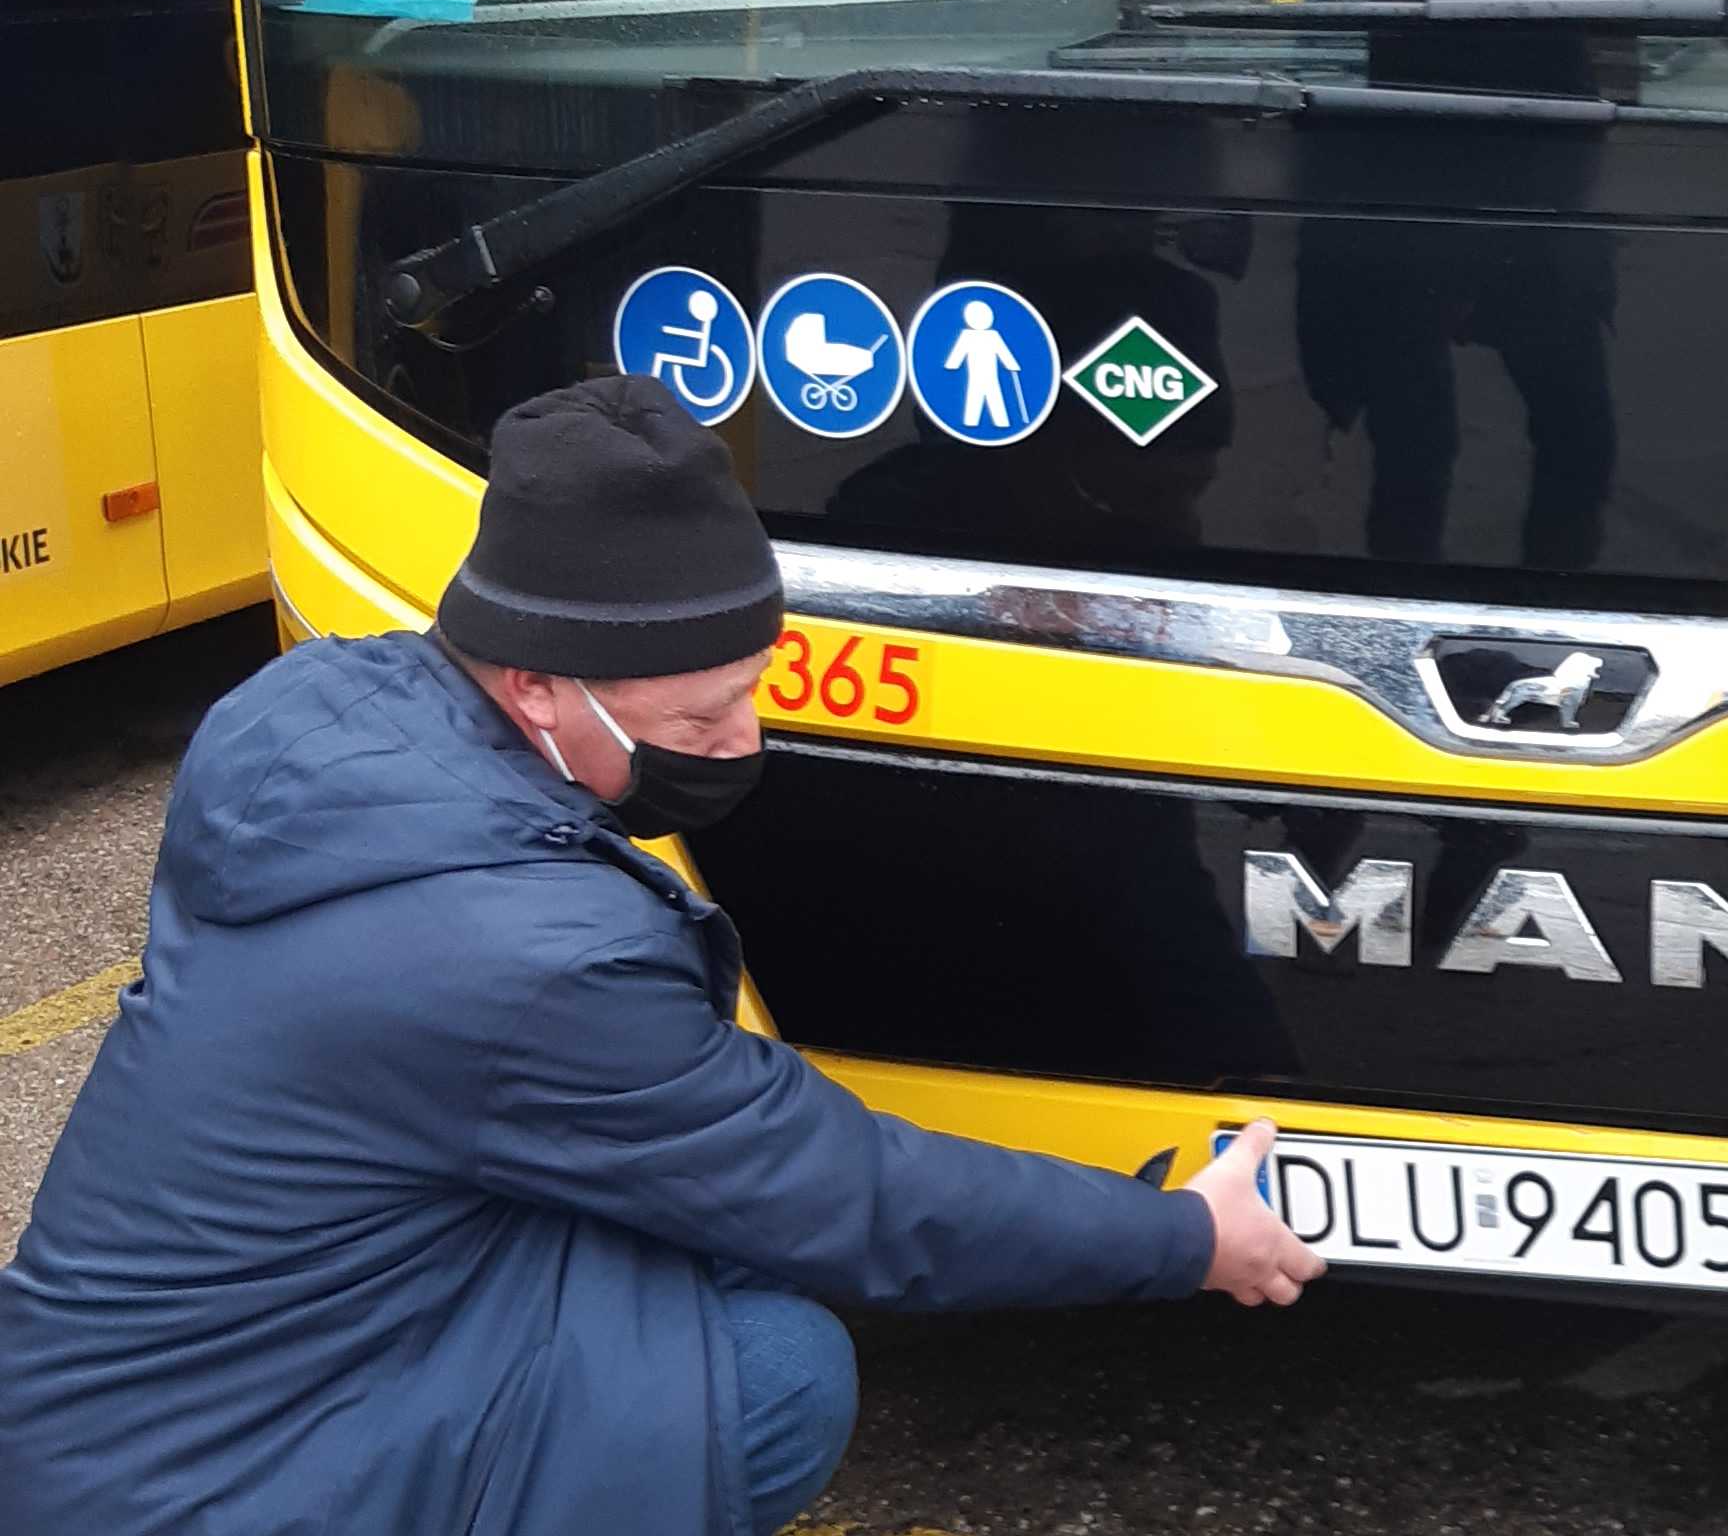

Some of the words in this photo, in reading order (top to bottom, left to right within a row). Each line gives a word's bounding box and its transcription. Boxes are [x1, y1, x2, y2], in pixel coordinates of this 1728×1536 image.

[1094, 362, 1185, 402] CNG
[0, 527, 50, 574] KIE
[752, 629, 919, 726] 365
[1274, 1152, 1465, 1253] DLU
